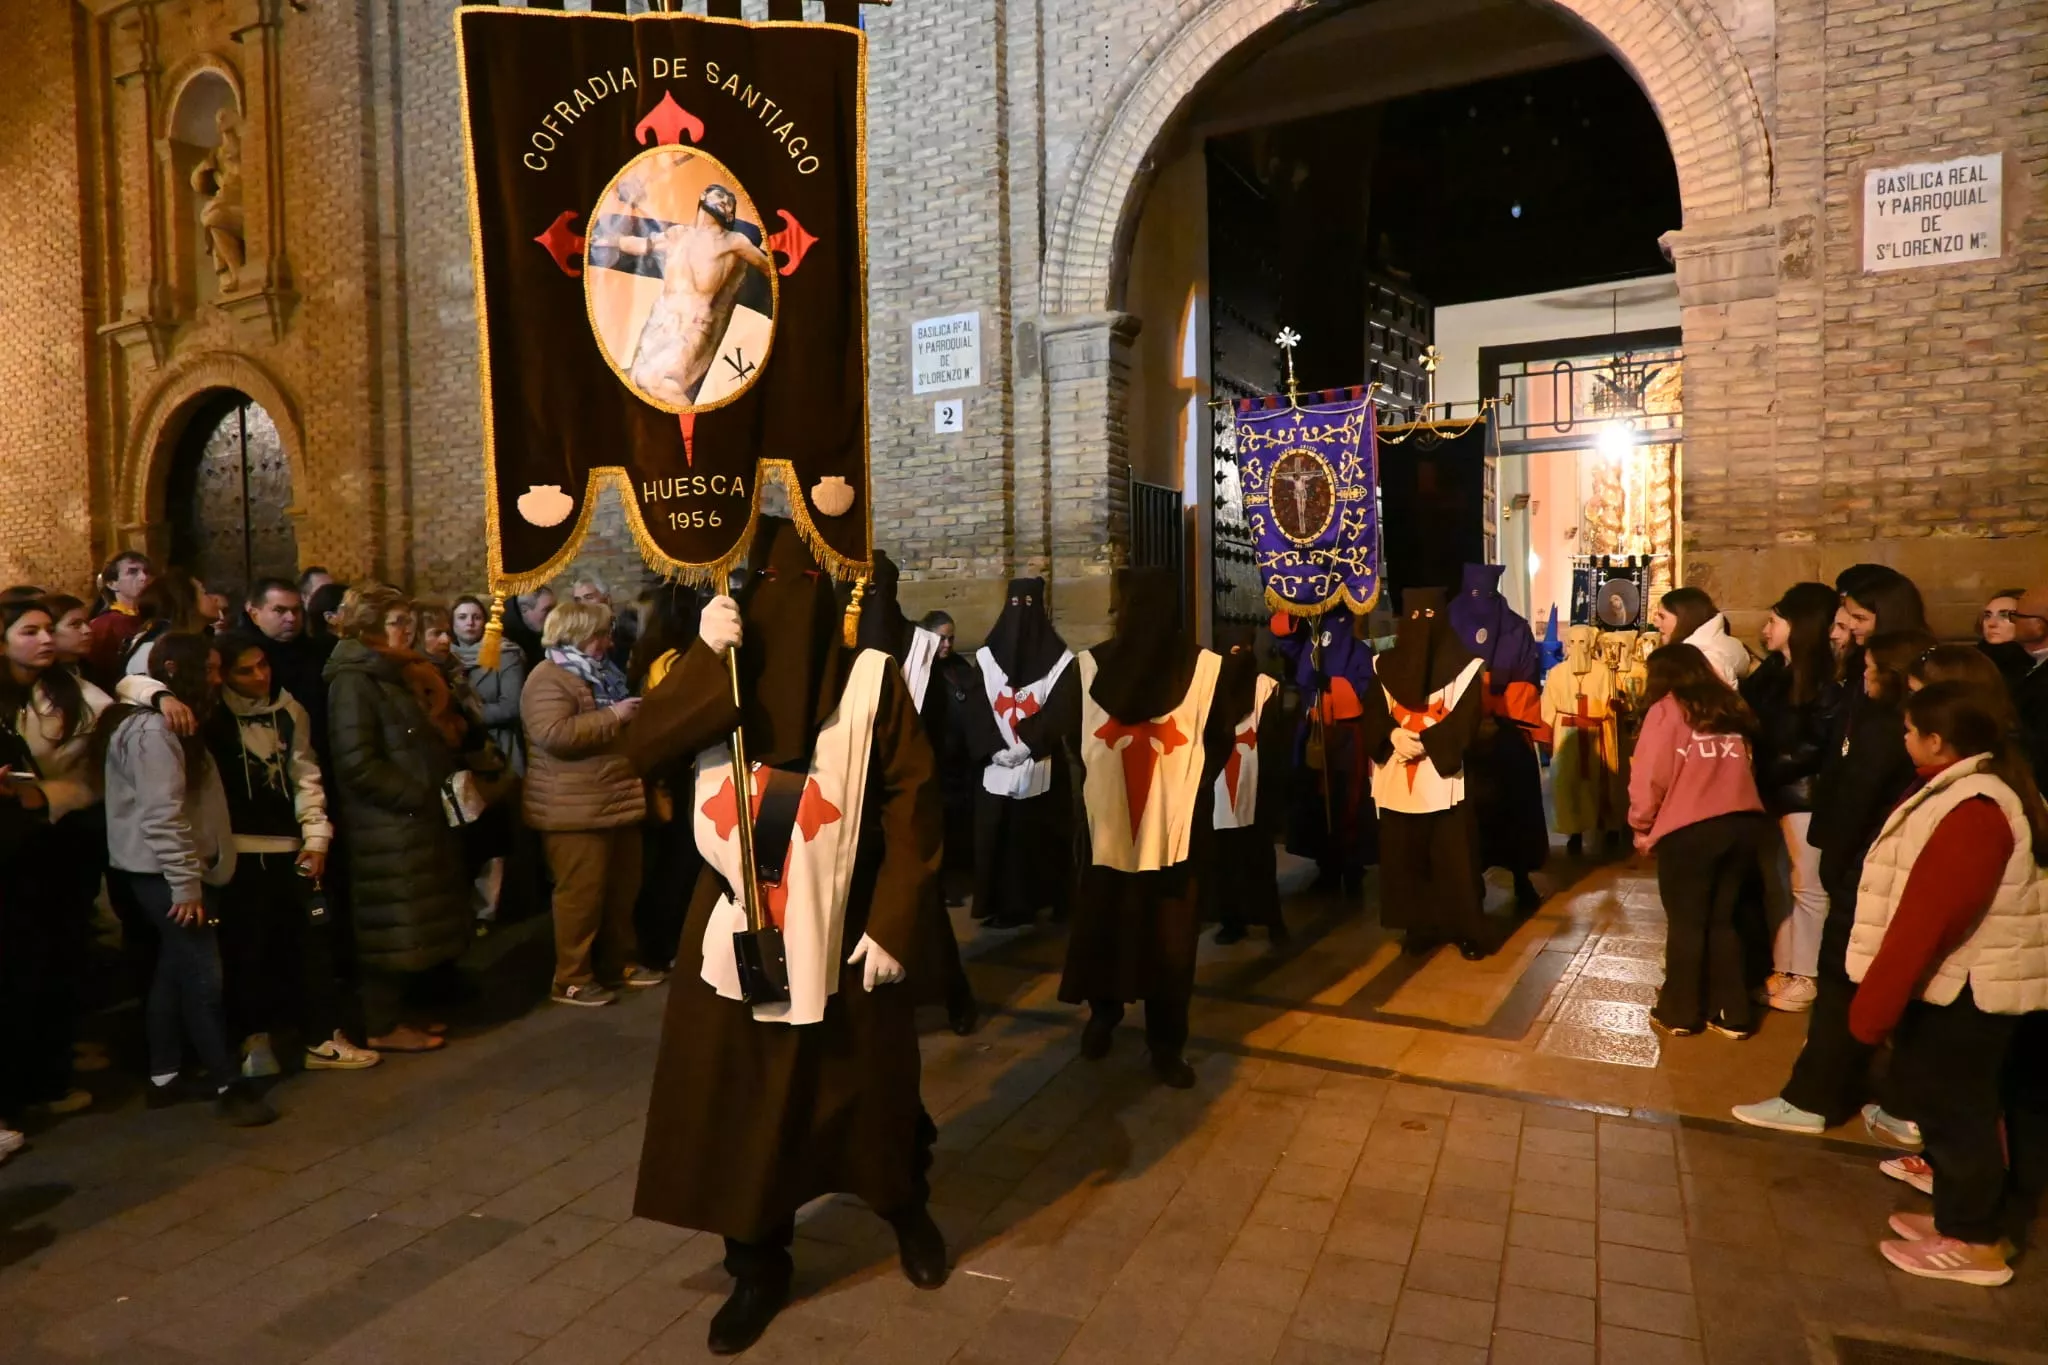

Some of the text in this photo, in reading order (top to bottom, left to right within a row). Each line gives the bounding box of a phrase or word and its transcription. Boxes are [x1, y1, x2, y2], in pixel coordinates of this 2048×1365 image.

[522, 57, 820, 175] COFRADIA DE SANTIAGO
[1949, 165, 1988, 185] REAL
[1877, 188, 1988, 217] Y PARROQUIAL
[1920, 214, 1942, 233] DE
[1893, 234, 1963, 259] LORENZO
[940, 354, 951, 367] DE
[942, 406, 954, 425] 2
[643, 475, 745, 503] HUESCA
[668, 510, 722, 531] 1956
